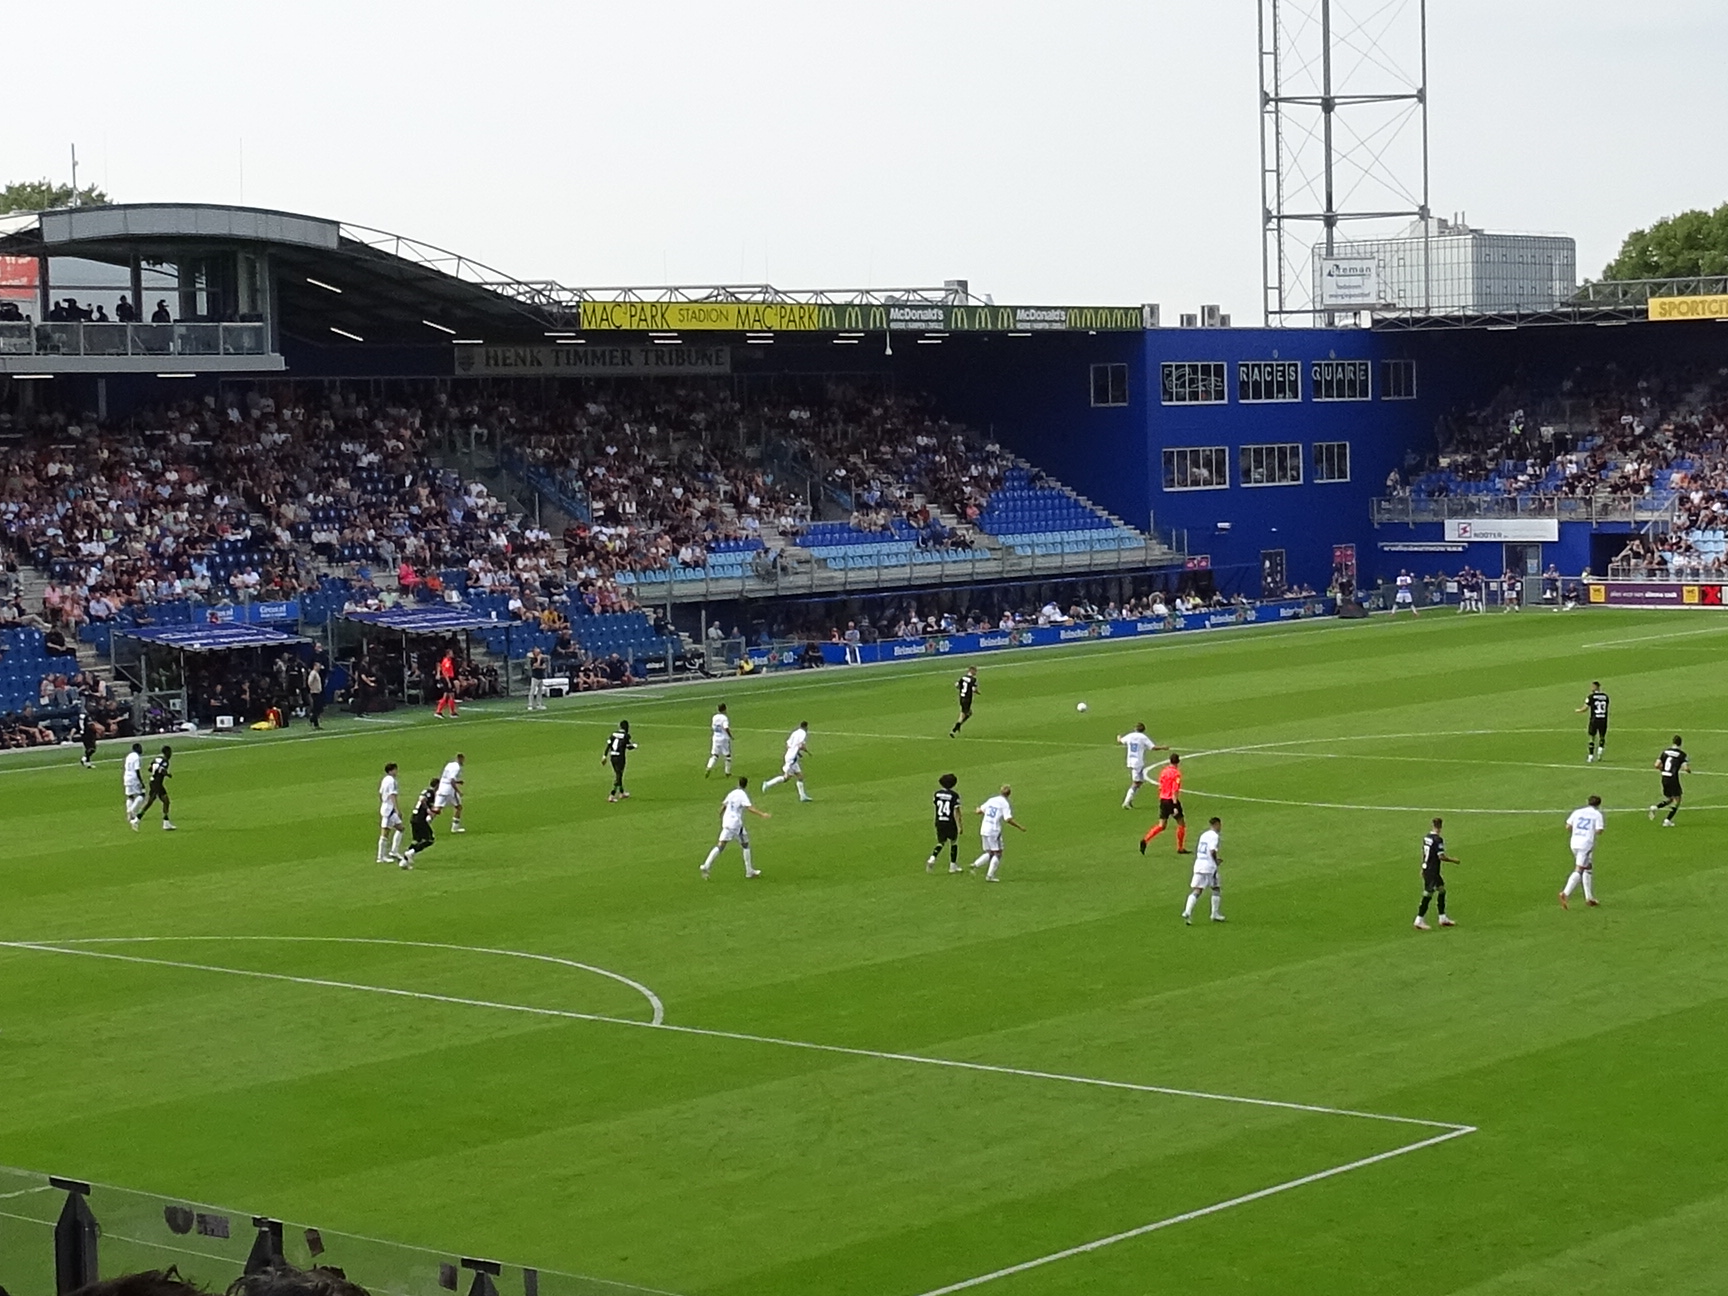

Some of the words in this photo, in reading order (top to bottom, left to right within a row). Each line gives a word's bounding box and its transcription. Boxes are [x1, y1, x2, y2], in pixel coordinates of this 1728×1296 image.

[678, 308, 729, 322] STADION
[890, 308, 943, 320] McDonald's
[484, 350, 543, 367] HENK
[551, 349, 633, 367] TIMMER
[641, 348, 724, 366] TRIBUNE
[936, 801, 951, 816] 24
[1577, 817, 1591, 830] 22
